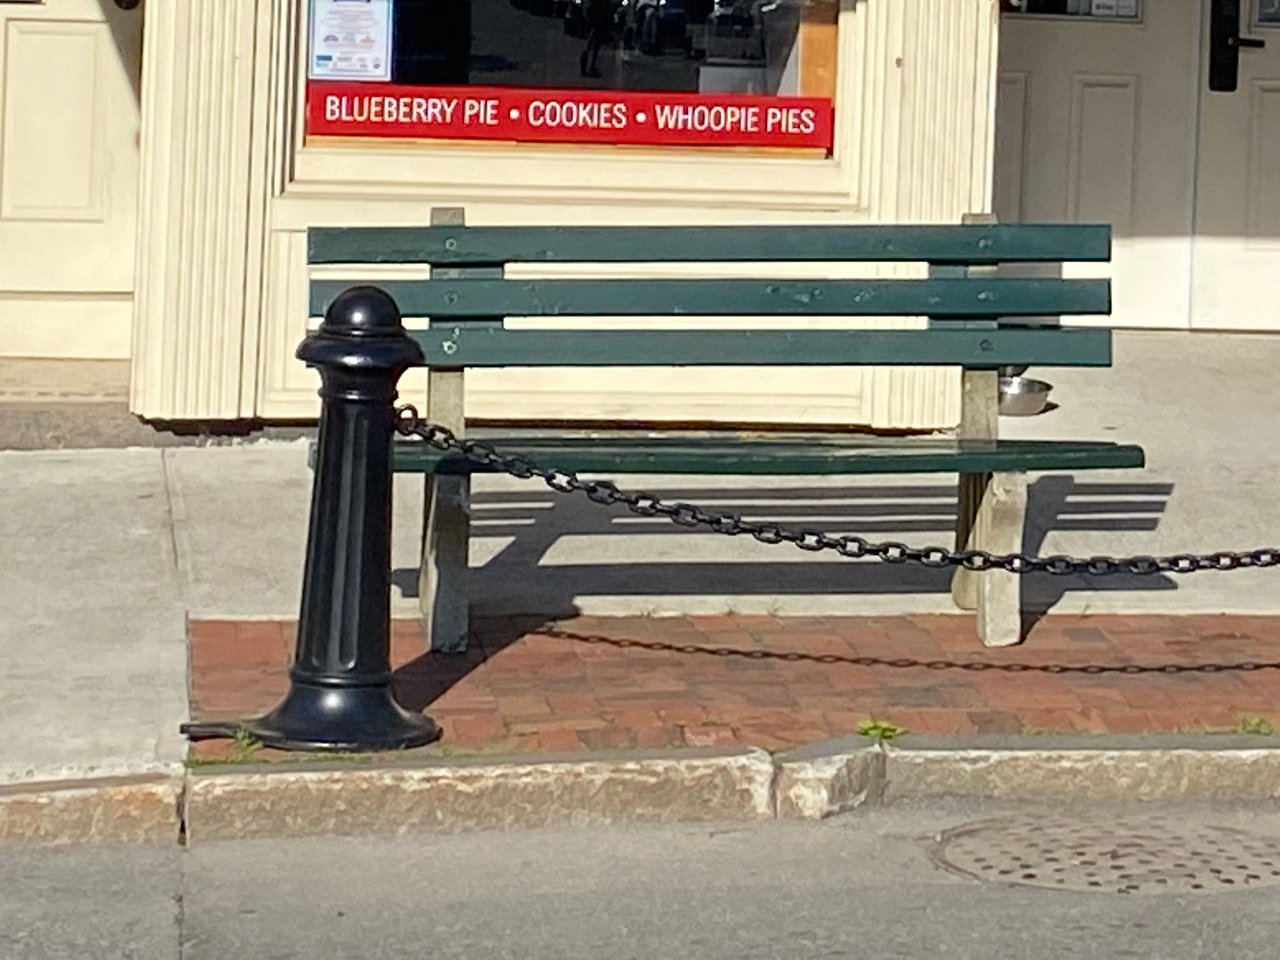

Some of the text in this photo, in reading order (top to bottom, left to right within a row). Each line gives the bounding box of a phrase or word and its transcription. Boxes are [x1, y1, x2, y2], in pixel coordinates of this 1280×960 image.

[325, 95, 816, 134] BLUEBERRY PIE COOKIES WHOOPIE PIES
